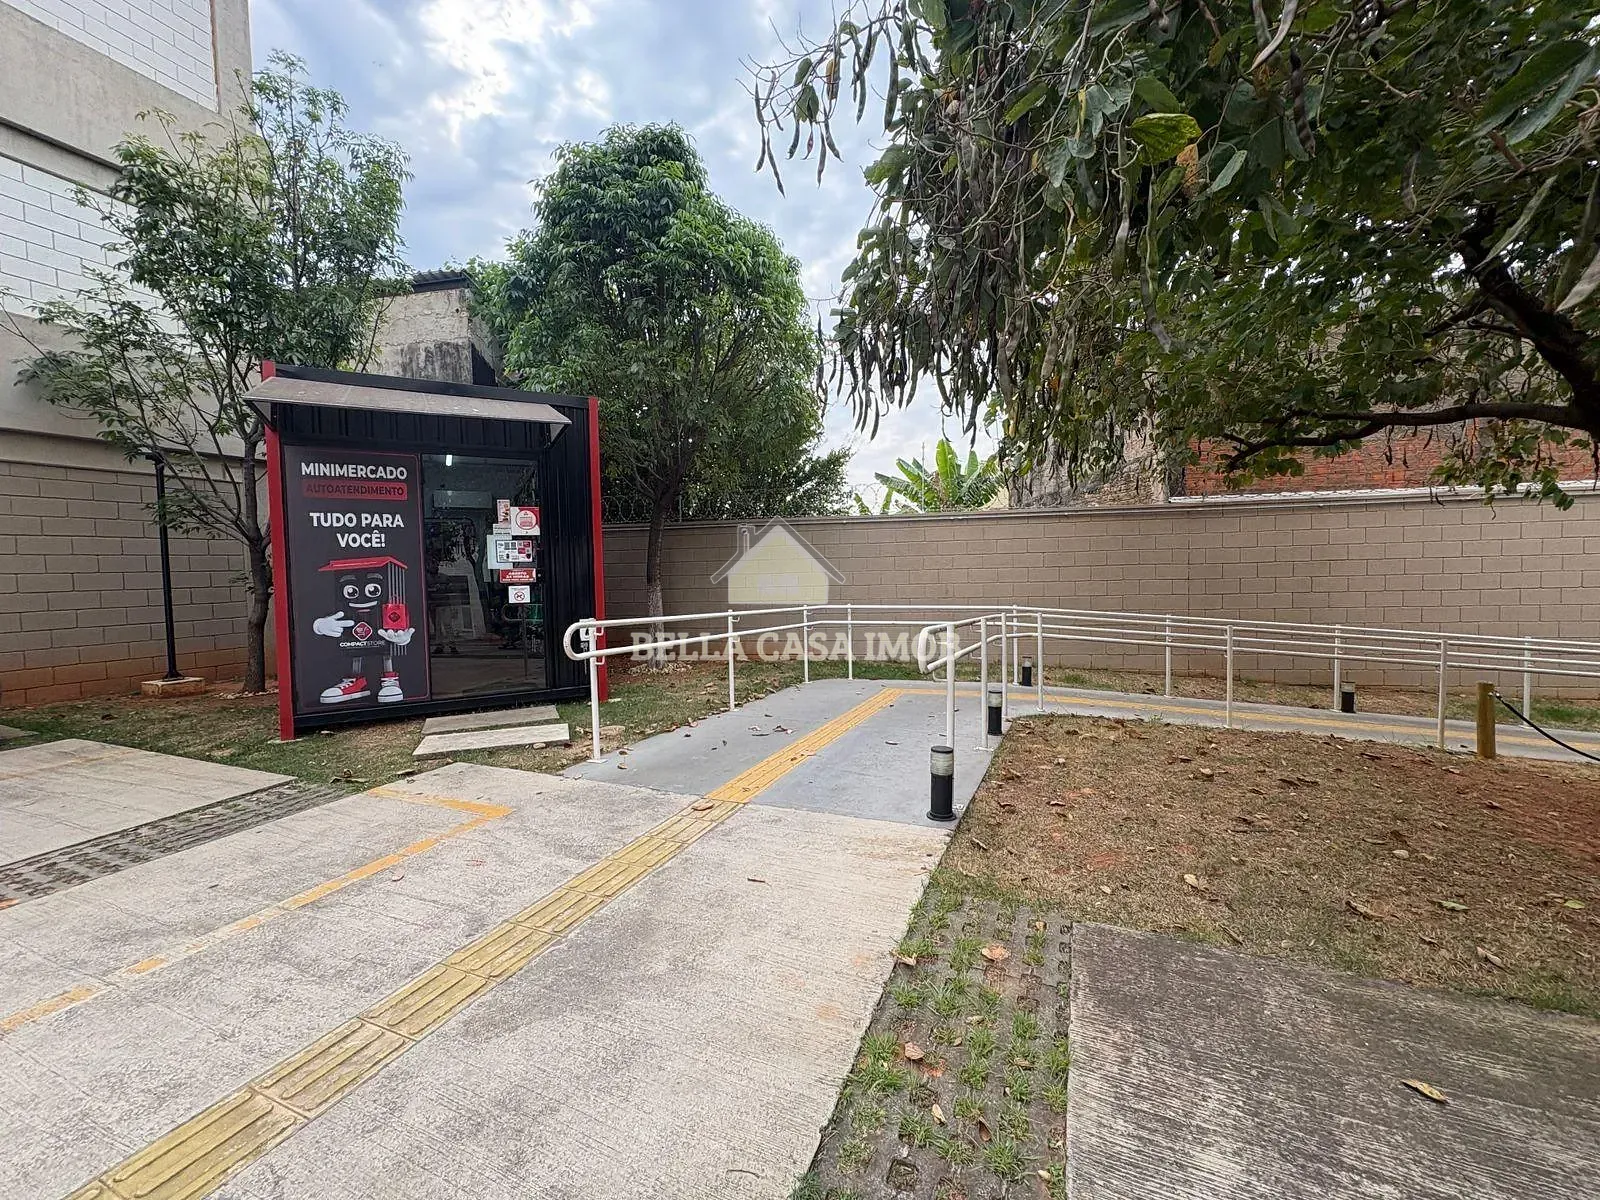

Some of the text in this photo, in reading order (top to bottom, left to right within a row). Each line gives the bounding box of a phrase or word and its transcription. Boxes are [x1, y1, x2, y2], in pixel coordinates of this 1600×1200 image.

[301, 462, 408, 480] MINIMERCADO
[306, 483, 404, 496] AUTOATENDIMENTO
[309, 512, 405, 528] TUDO PARA
[336, 530, 386, 548] VOCÊ!
